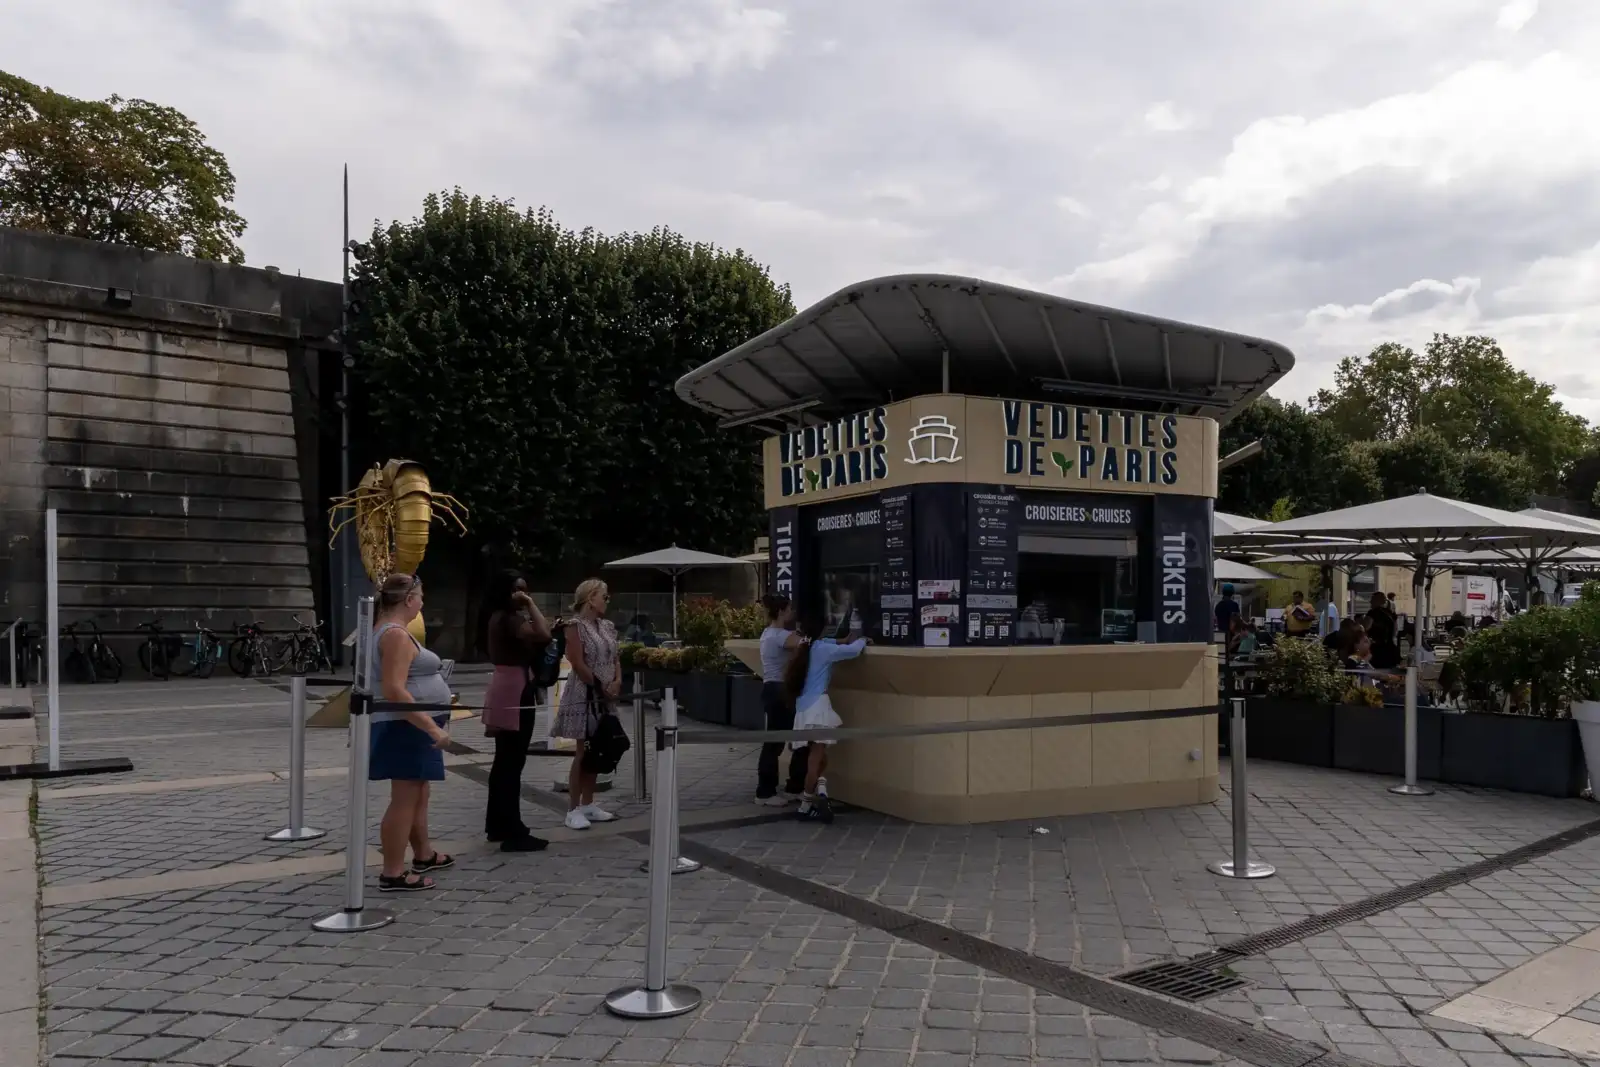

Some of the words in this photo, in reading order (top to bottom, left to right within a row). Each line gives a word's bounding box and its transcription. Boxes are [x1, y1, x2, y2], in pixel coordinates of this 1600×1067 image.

[780, 407, 887, 464] VEDETTES
[1002, 400, 1177, 449] VEDETTES
[781, 463, 806, 496] DE
[820, 444, 888, 490] PARIS
[1005, 439, 1045, 476] DE
[1079, 444, 1177, 485] PARIS
[817, 513, 852, 531] CROISIERES
[1025, 505, 1086, 522] CROISIERES
[1092, 508, 1131, 524] CRUISES
[776, 521, 793, 601] TICKE
[1162, 531, 1186, 624] TICKETS
